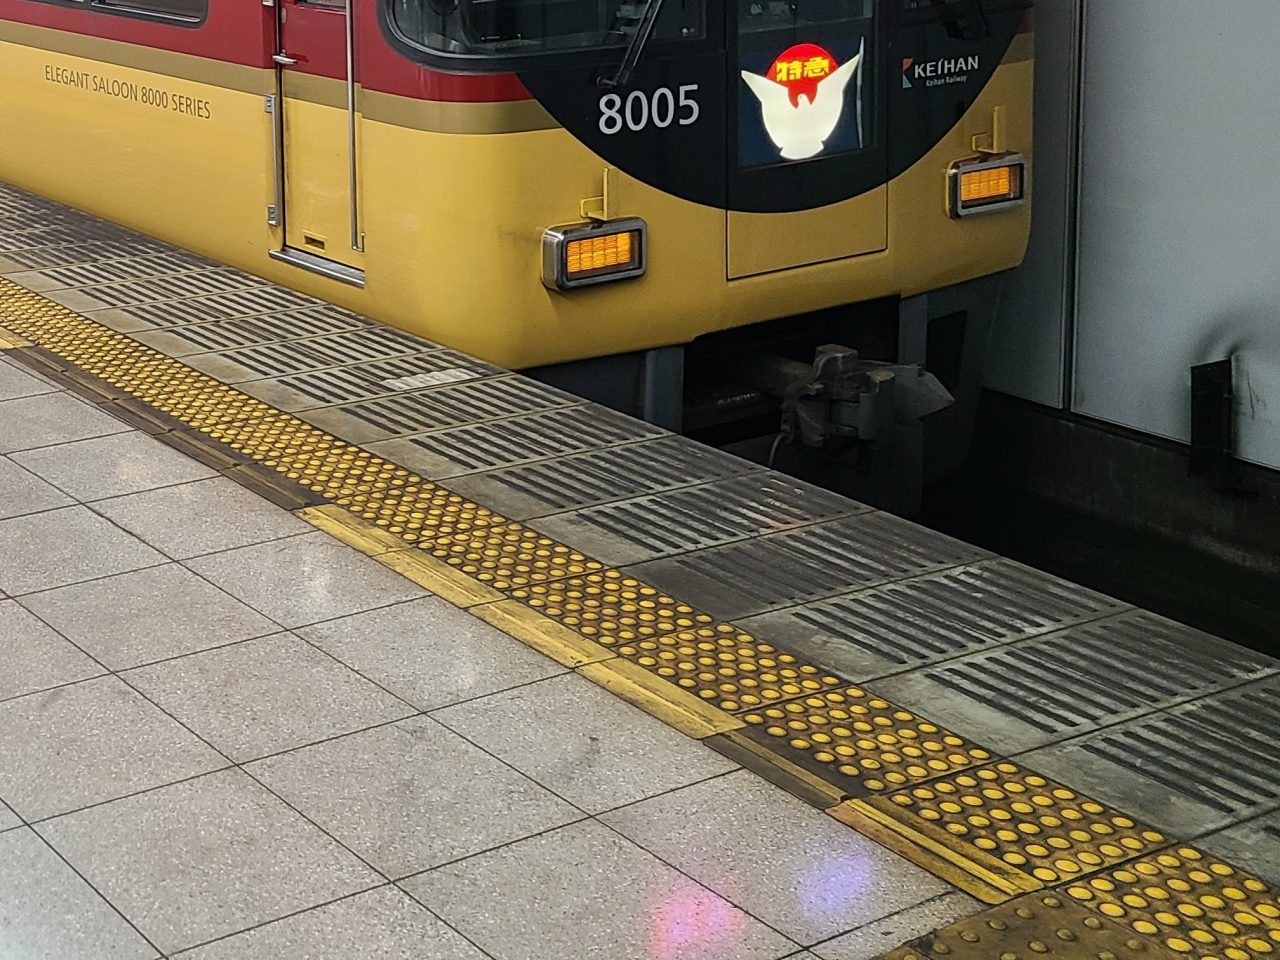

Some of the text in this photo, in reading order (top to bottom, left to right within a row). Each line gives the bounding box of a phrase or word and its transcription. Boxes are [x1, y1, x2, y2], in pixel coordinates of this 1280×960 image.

[776, 56, 829, 82] 特急
[914, 55, 979, 79] KEIHAN
[44, 64, 211, 120] ELEGANT SALOON 8000 SERIES
[598, 83, 700, 135] 8005
